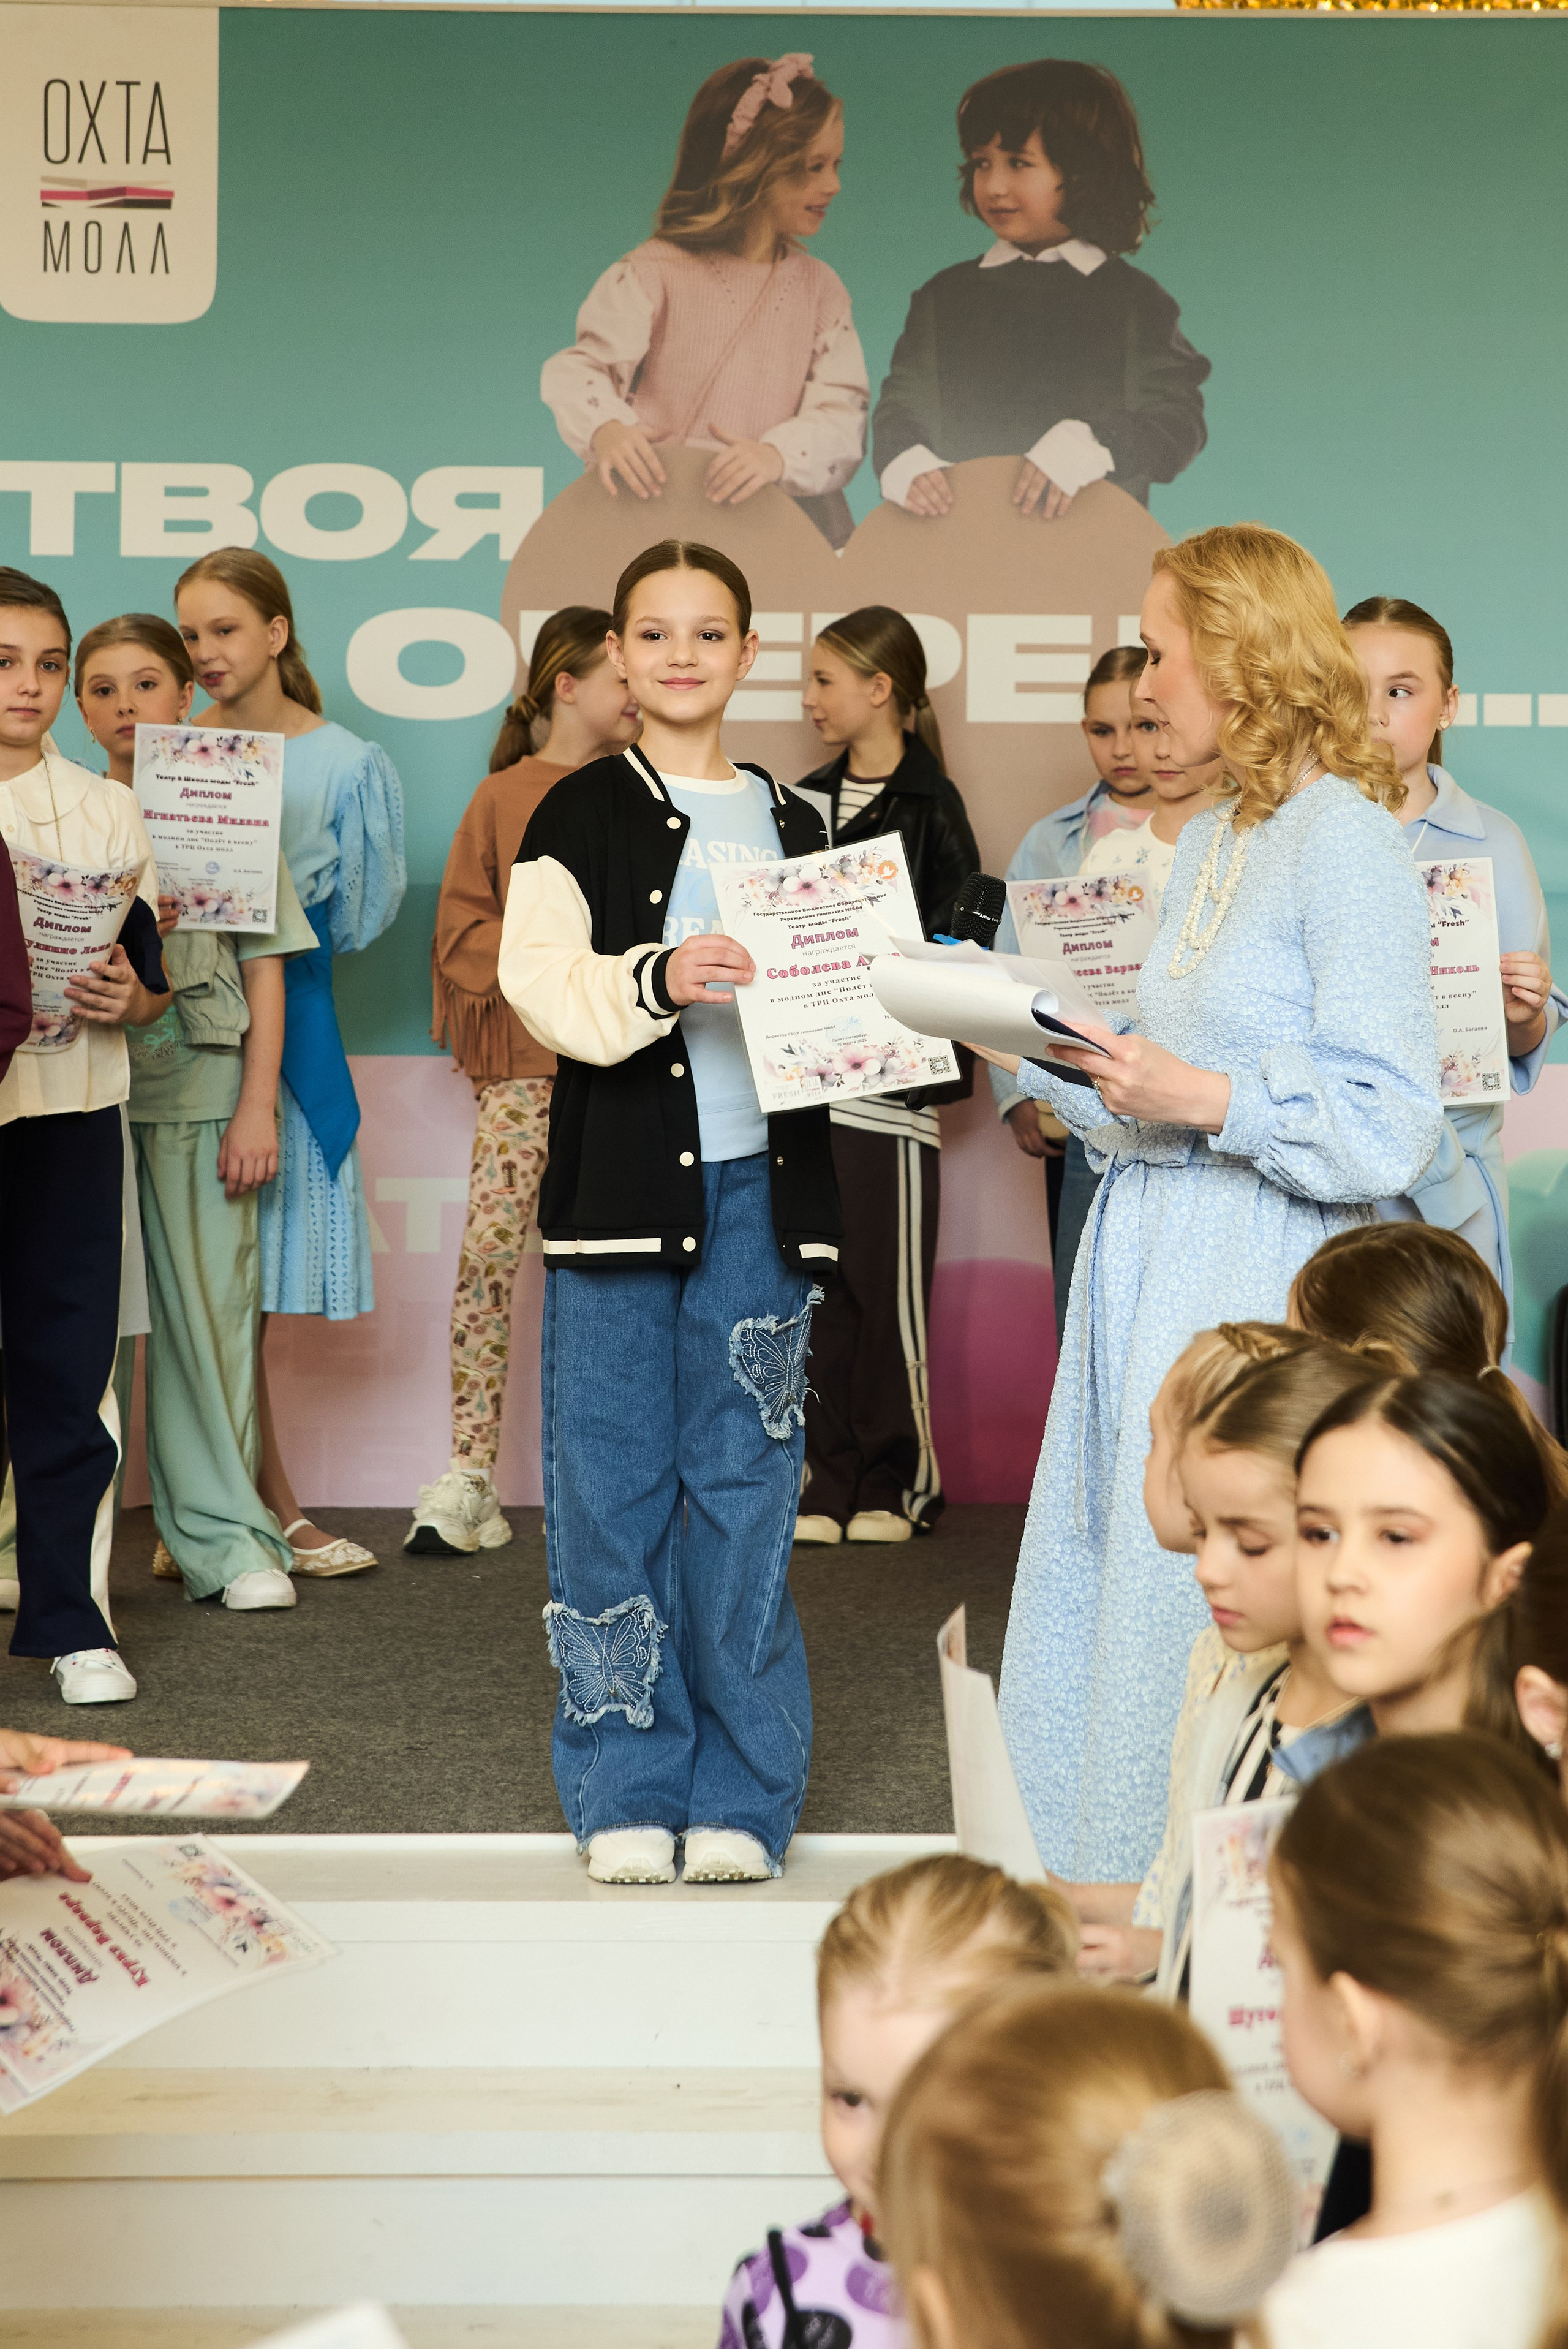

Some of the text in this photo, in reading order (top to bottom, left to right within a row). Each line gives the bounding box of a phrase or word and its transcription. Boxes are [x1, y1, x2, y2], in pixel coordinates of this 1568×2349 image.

[43, 78, 172, 165] ОХТА
[43, 220, 170, 274] МОЛЛ
[0, 460, 544, 561] ТВОЯ
[179, 787, 232, 800] Диплом
[217, 814, 270, 826] Милана
[678, 838, 778, 869] ASIN
[802, 903, 836, 912] Бюджетное
[780, 913, 816, 922] Учреждение
[816, 909, 844, 917] гимназия
[33, 916, 92, 933] Диплом
[39, 932, 85, 942] награждается
[791, 928, 859, 950] Диплом
[802, 944, 856, 957] награждается
[1062, 939, 1113, 955] Диплом
[766, 960, 852, 980] Соболева
[1430, 964, 1480, 975] Николь
[824, 975, 861, 987] участие
[777, 993, 813, 1002] модном
[815, 989, 832, 998] дне
[810, 999, 830, 1008] ТРЦ
[59, 1892, 111, 1945] Варвара
[40, 1927, 98, 1984] Диплом
